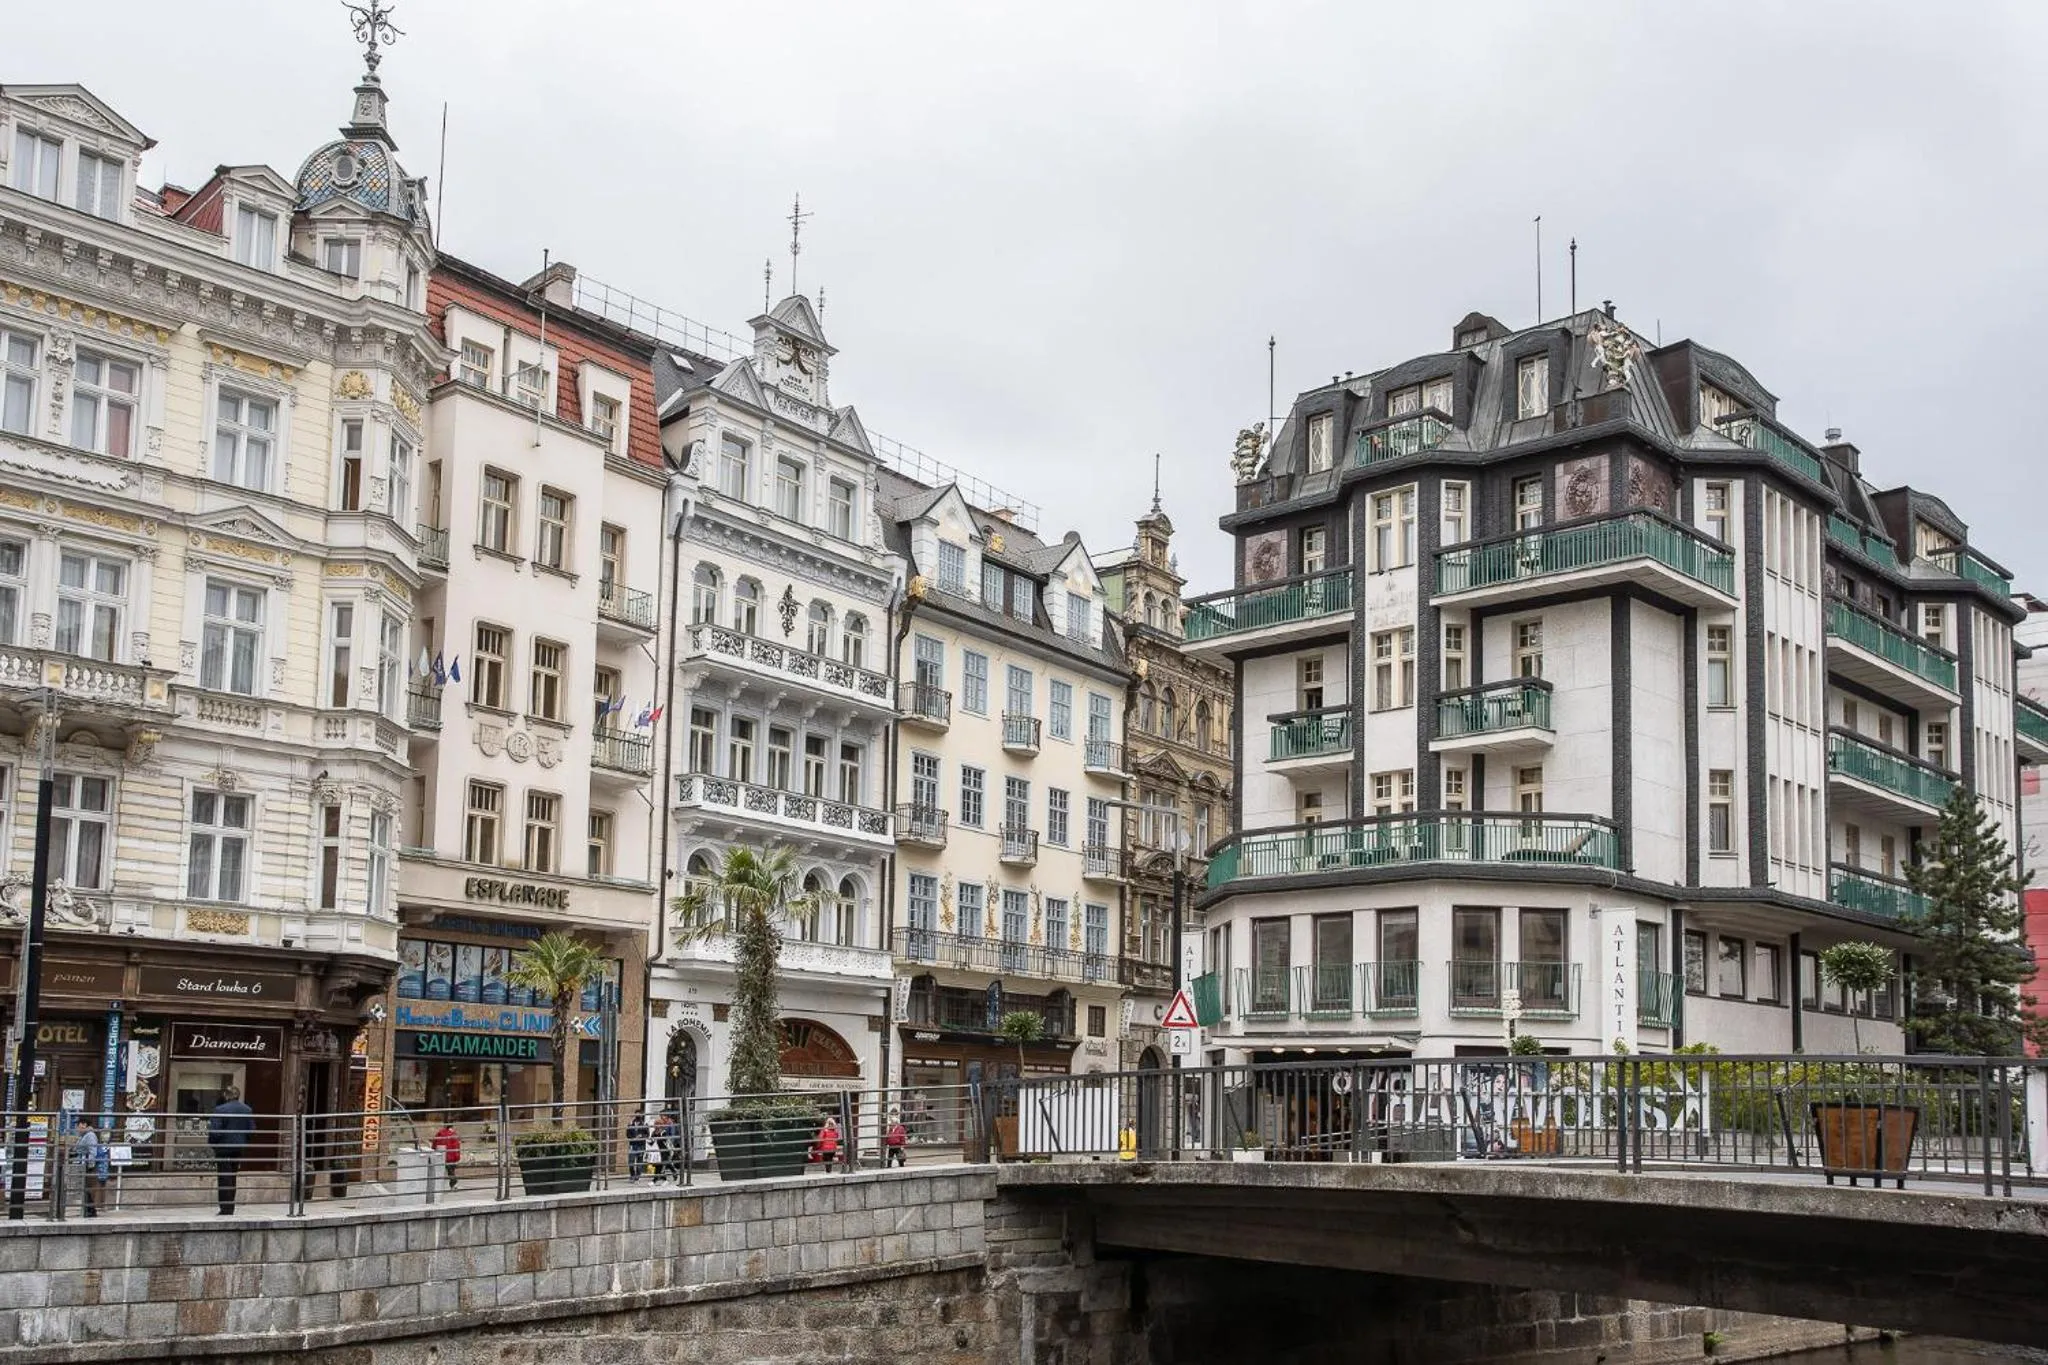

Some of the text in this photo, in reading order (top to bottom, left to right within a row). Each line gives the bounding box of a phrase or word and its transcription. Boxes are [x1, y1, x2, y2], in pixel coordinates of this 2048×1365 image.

[465, 877, 570, 909] ESPLANADE
[216, 979, 248, 993] louka
[252, 982, 262, 994] 6
[37, 1026, 88, 1043] OTEL
[109, 1016, 119, 1046] Clinic
[677, 1018, 712, 1040] BOHEMIA
[189, 1034, 266, 1050] Diamonds
[418, 1033, 538, 1057] SALAMANDER
[1174, 1036, 1182, 1048] 2
[365, 1086, 382, 1149] EXCANGE
